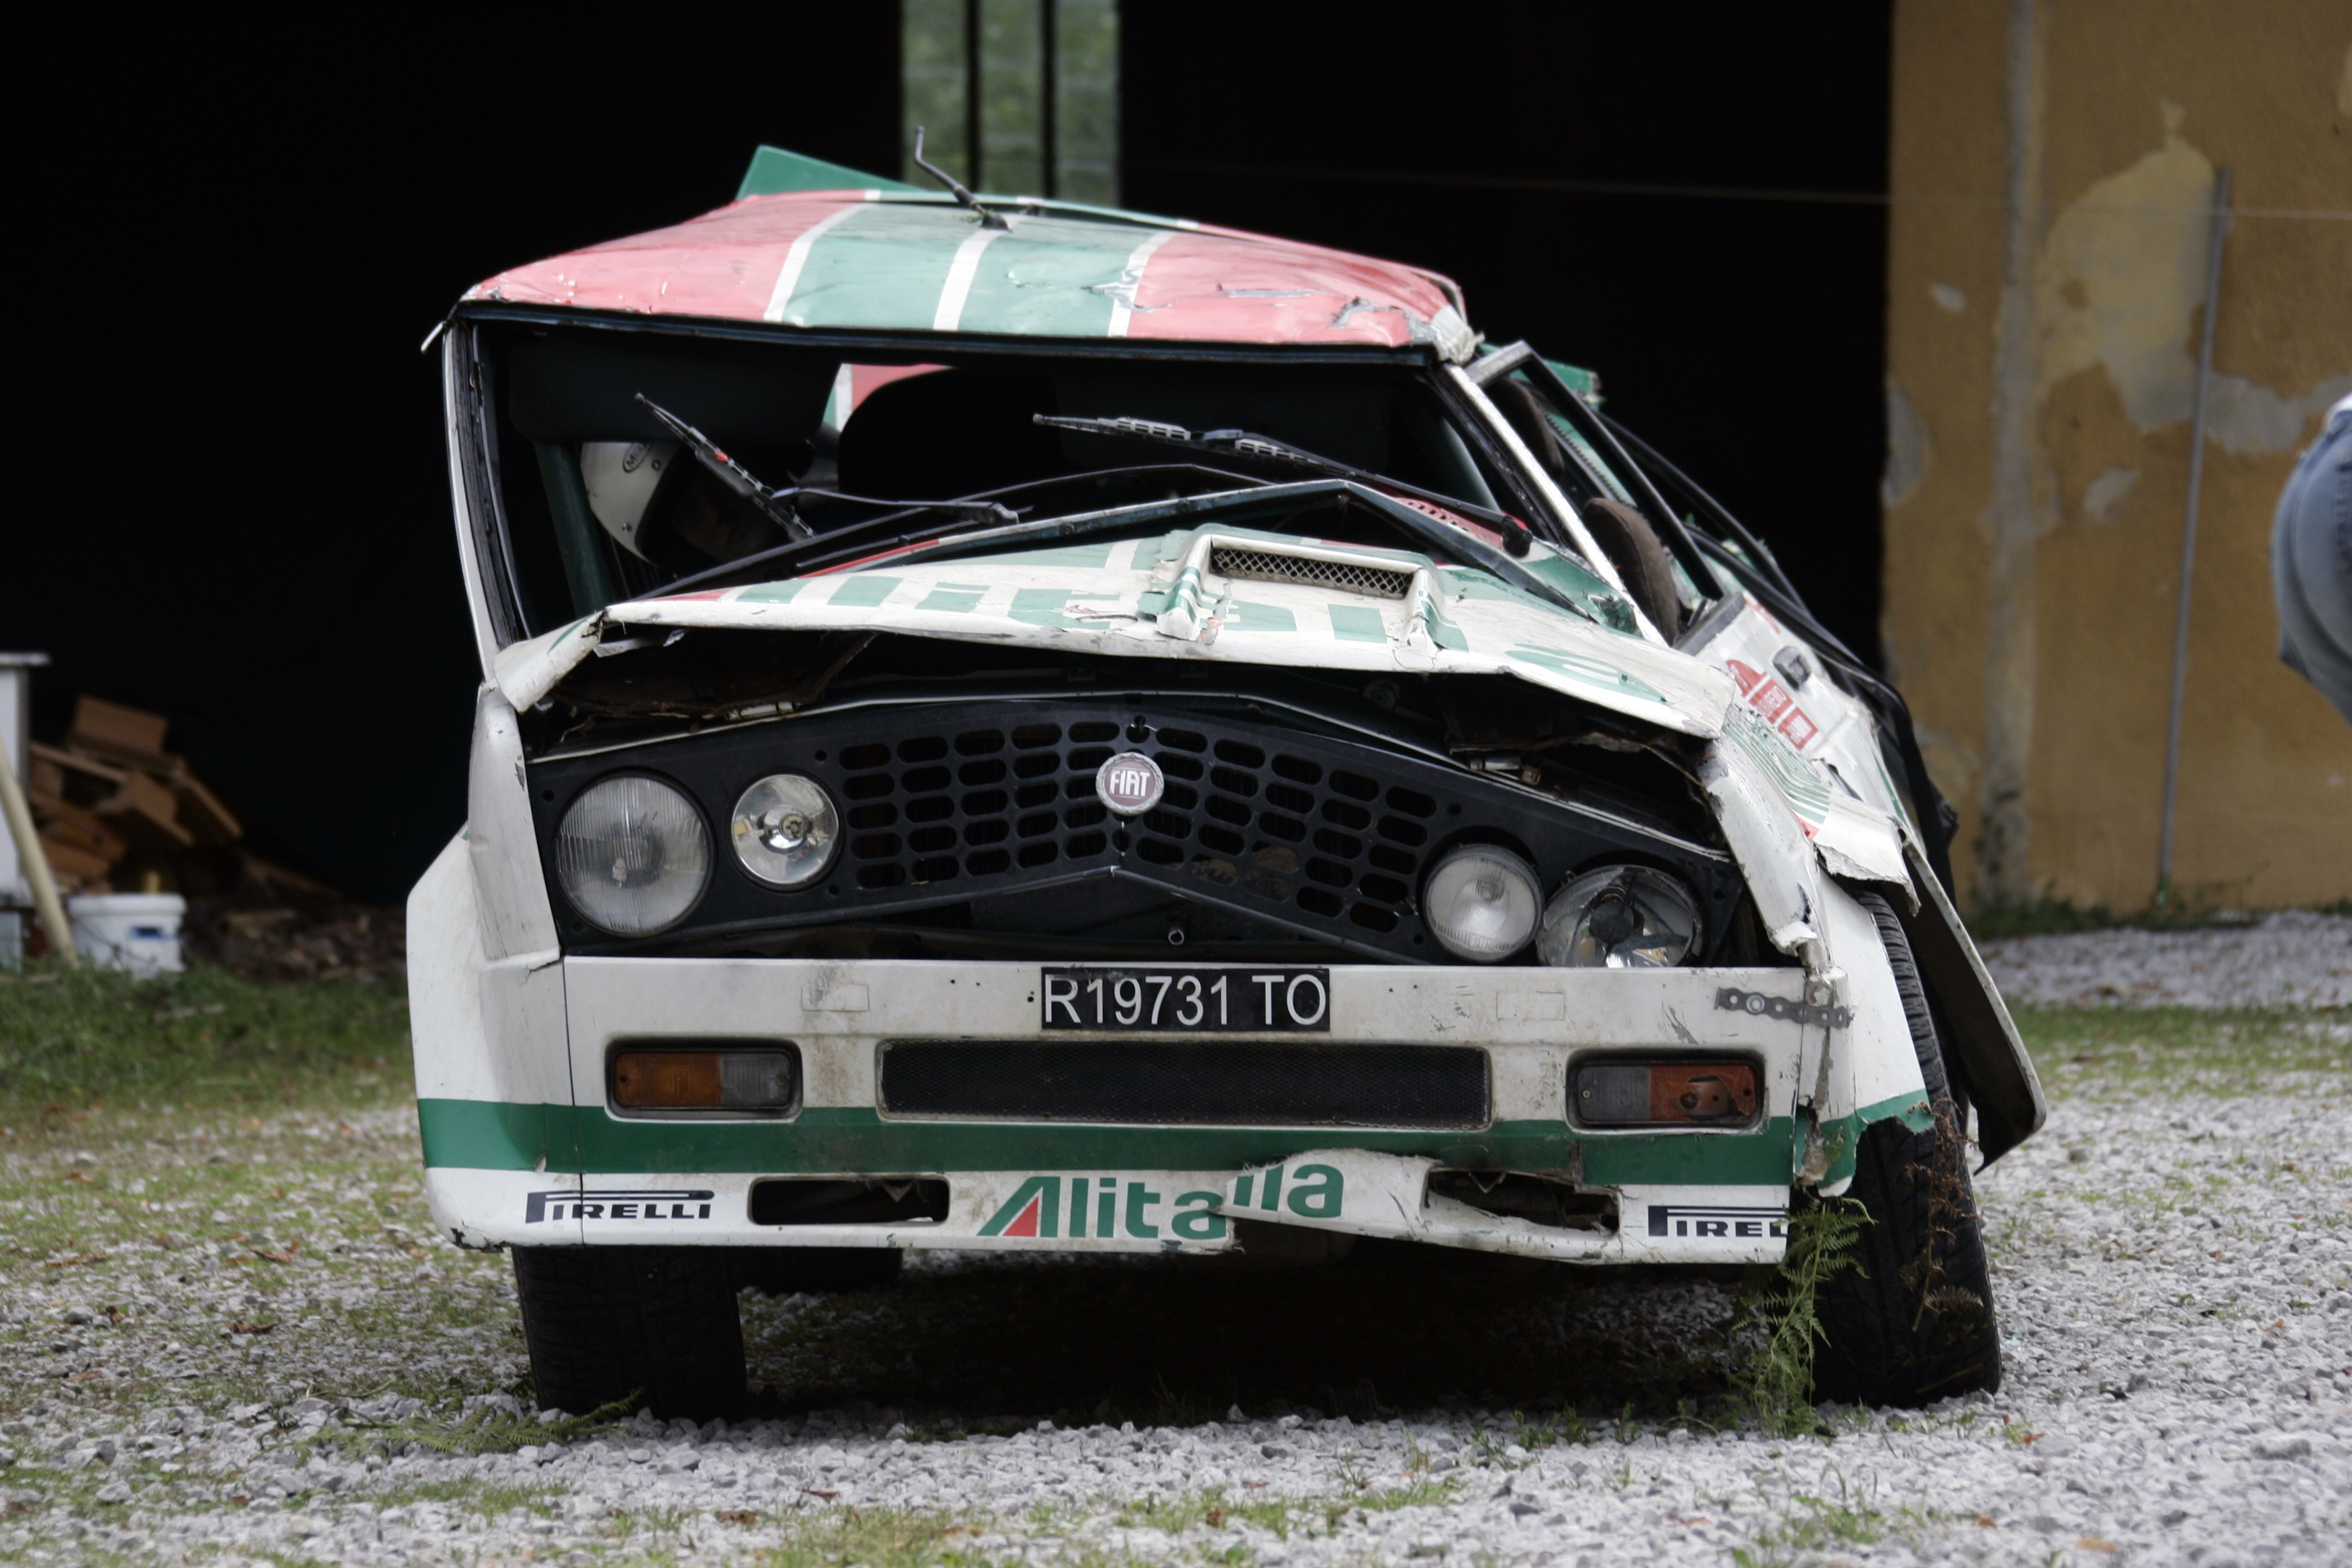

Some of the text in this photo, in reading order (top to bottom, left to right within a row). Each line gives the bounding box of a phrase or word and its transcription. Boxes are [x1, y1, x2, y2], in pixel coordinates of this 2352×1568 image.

[1109, 769, 1151, 797] FIAT
[1044, 973, 1327, 1026] R19731 TO
[526, 1189, 715, 1224] PIRELLI
